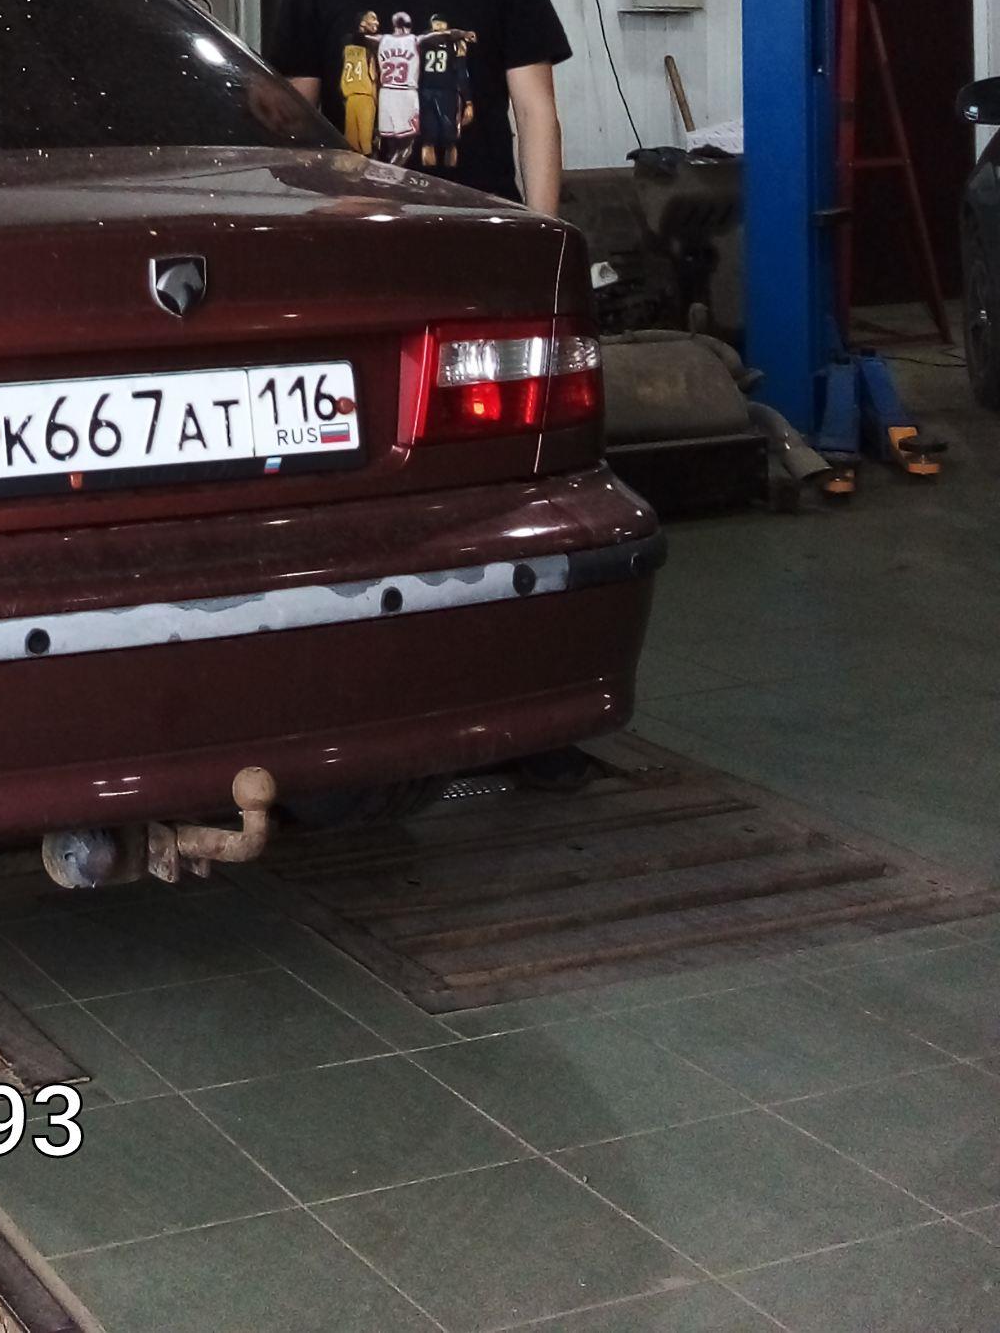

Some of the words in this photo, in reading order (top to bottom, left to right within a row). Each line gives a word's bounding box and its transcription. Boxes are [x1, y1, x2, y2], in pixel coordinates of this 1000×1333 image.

[345, 61, 362, 82] 24
[425, 50, 448, 73] 23
[381, 62, 408, 84] 23
[258, 374, 338, 425] 116
[277, 427, 318, 446] RUS
